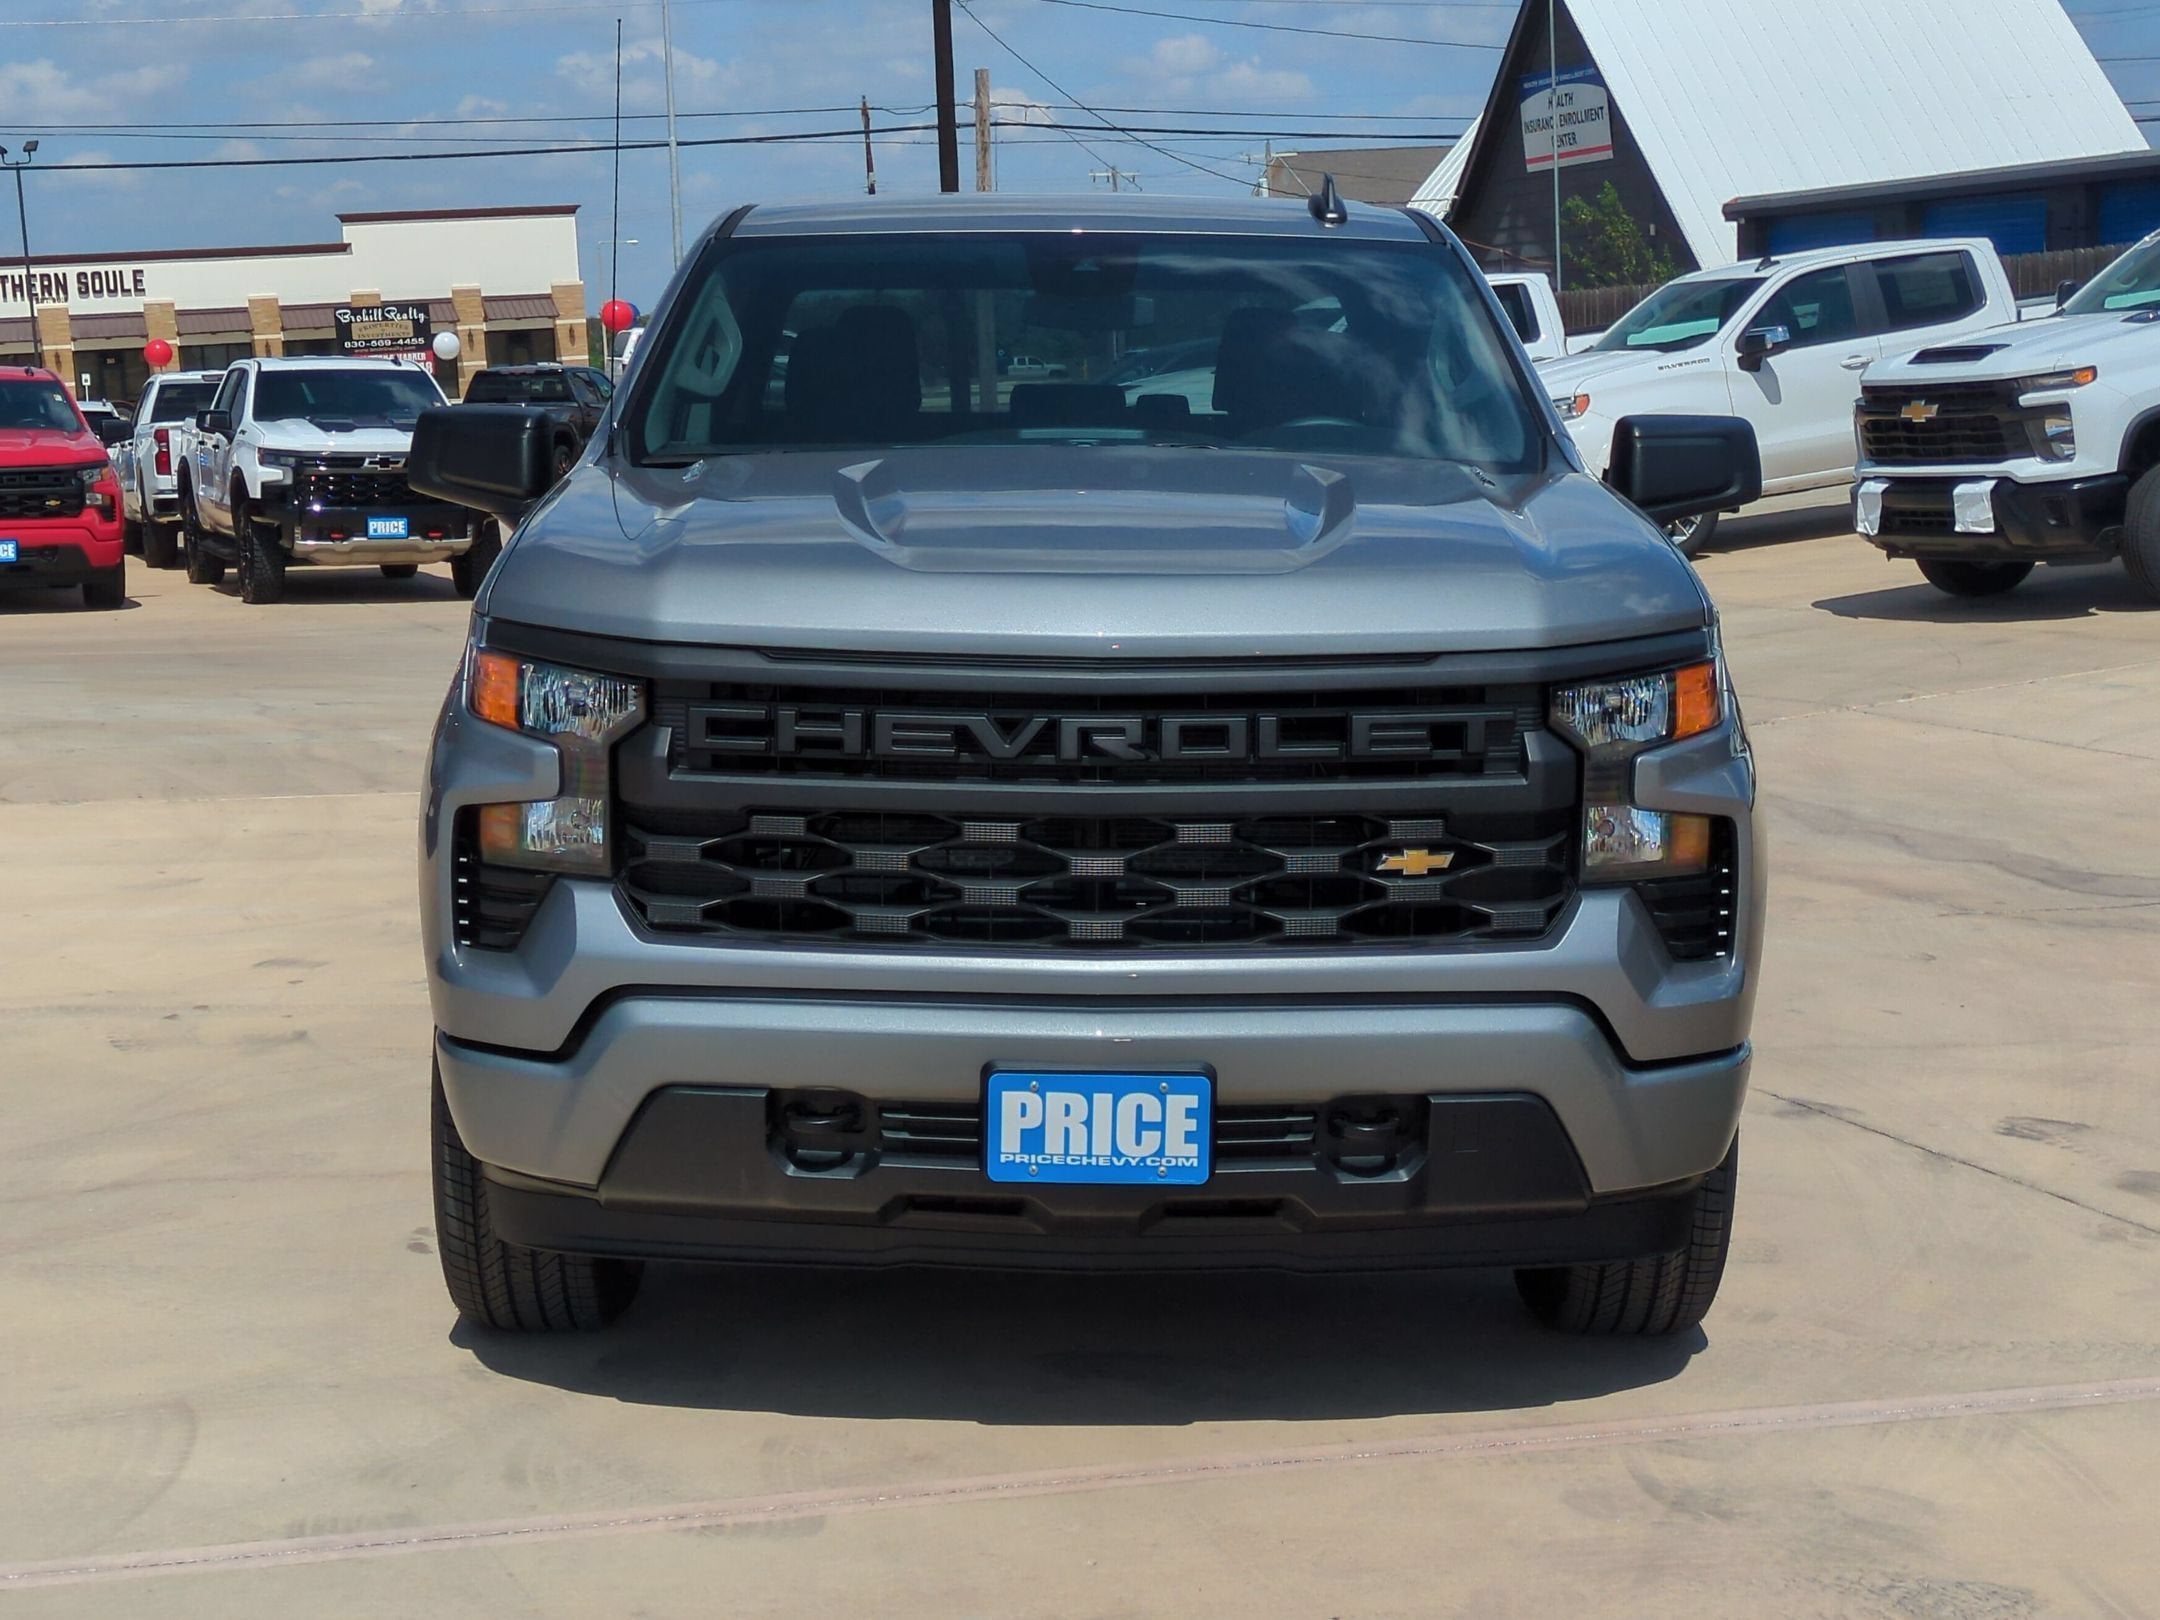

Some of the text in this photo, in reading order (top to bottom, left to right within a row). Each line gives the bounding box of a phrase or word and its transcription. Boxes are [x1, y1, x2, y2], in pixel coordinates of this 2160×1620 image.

[1547, 92, 1574, 110] HALTH
[1524, 106, 1604, 134] INSURANC ENROLLMENT
[76, 269, 146, 299] SOULE
[336, 308, 382, 323] Brohill
[1657, 358, 1710, 370] SILVERADO
[370, 521, 405, 534] PRICE
[687, 705, 1514, 762] CHEVROLET
[1001, 1091, 1198, 1156] PRICE
[1000, 1154, 1198, 1167] PRICECHEVY.COM
